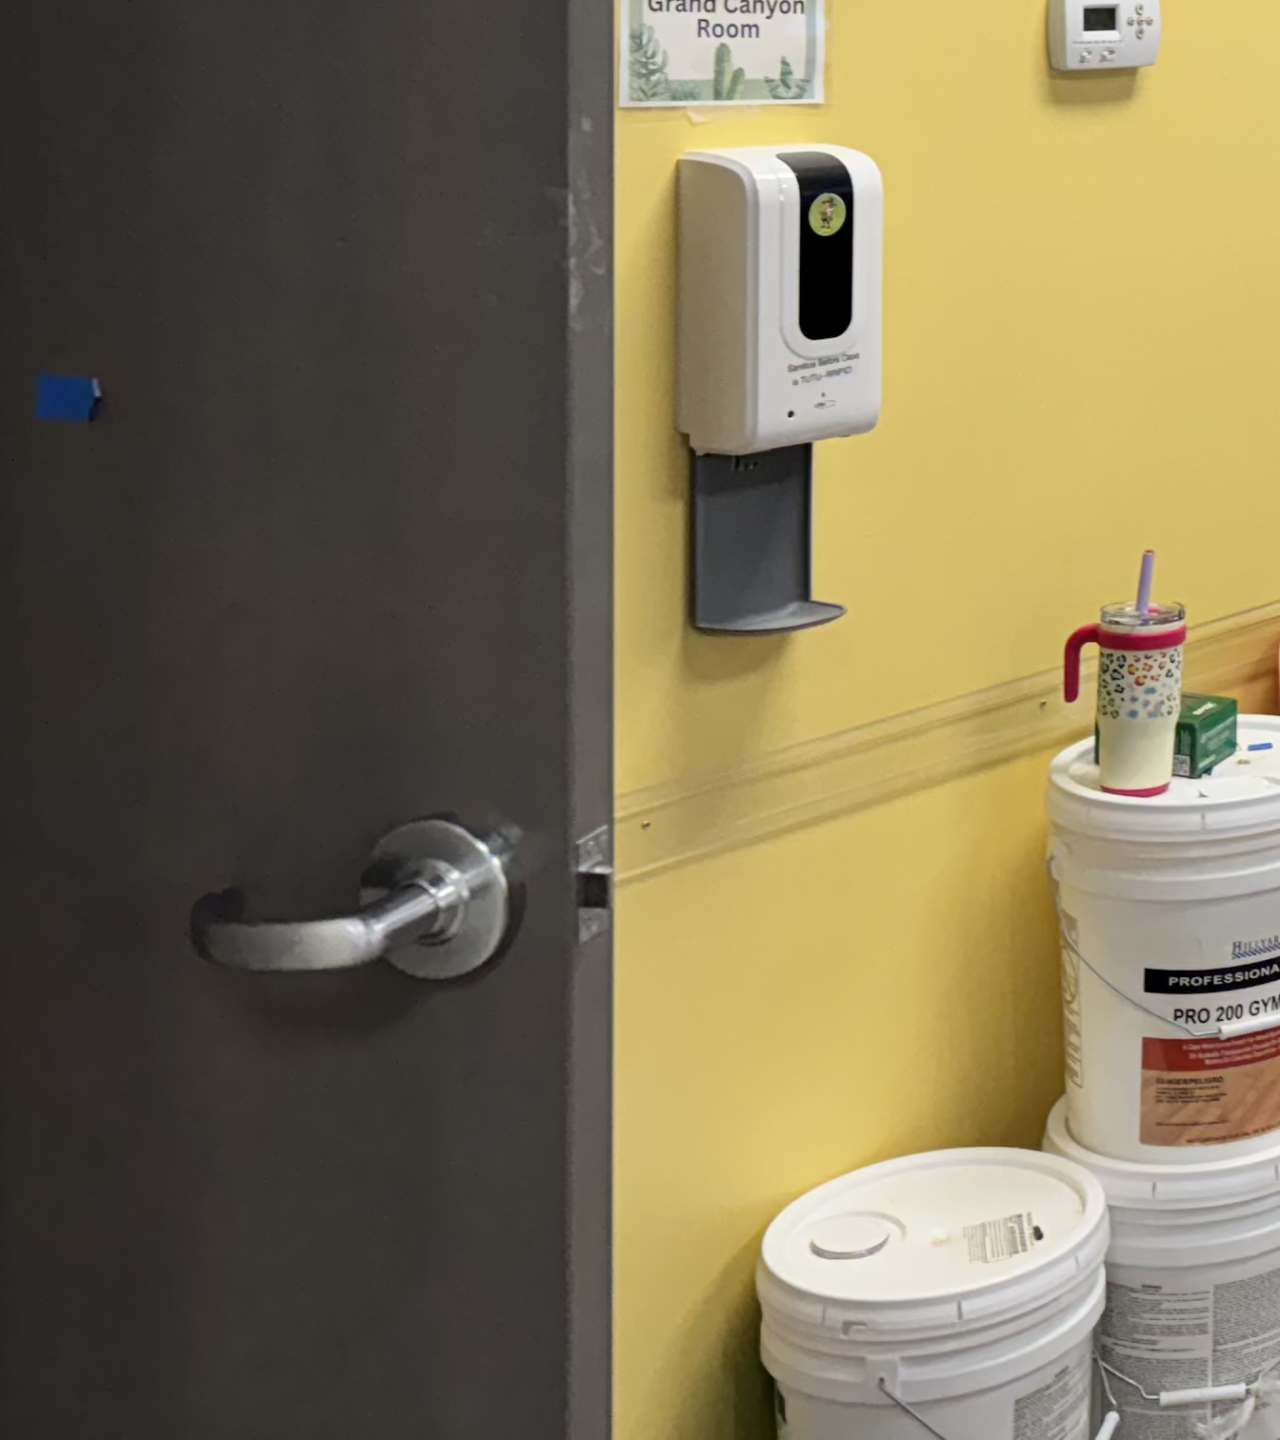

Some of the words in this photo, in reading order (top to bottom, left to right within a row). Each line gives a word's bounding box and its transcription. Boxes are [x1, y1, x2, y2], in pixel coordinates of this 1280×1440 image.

[697, 18, 760, 38] Room
[1174, 1008, 1210, 1024] PRO
[1216, 1003, 1243, 1022] 200
